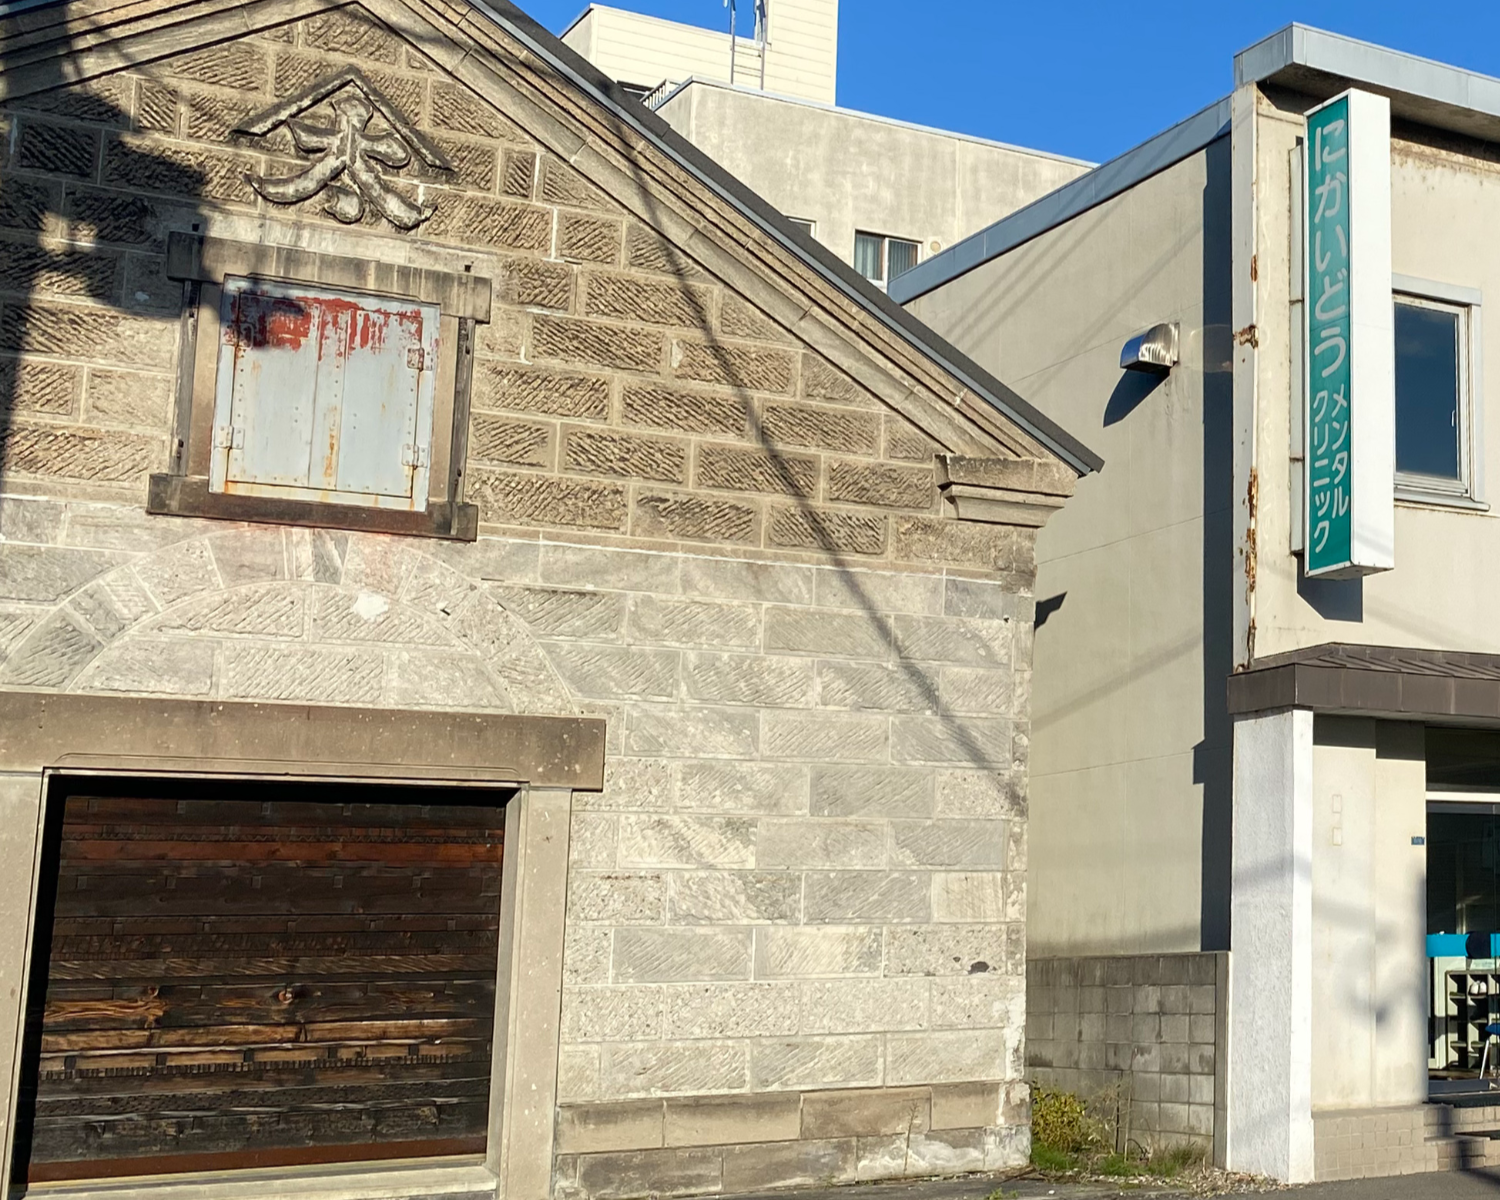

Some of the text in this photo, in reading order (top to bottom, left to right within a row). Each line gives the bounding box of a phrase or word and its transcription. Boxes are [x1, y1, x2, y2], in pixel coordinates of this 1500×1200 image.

[1314, 117, 1348, 378] にかいどう
[1312, 389, 1331, 554] クリニック
[1331, 384, 1350, 519] メンタル
